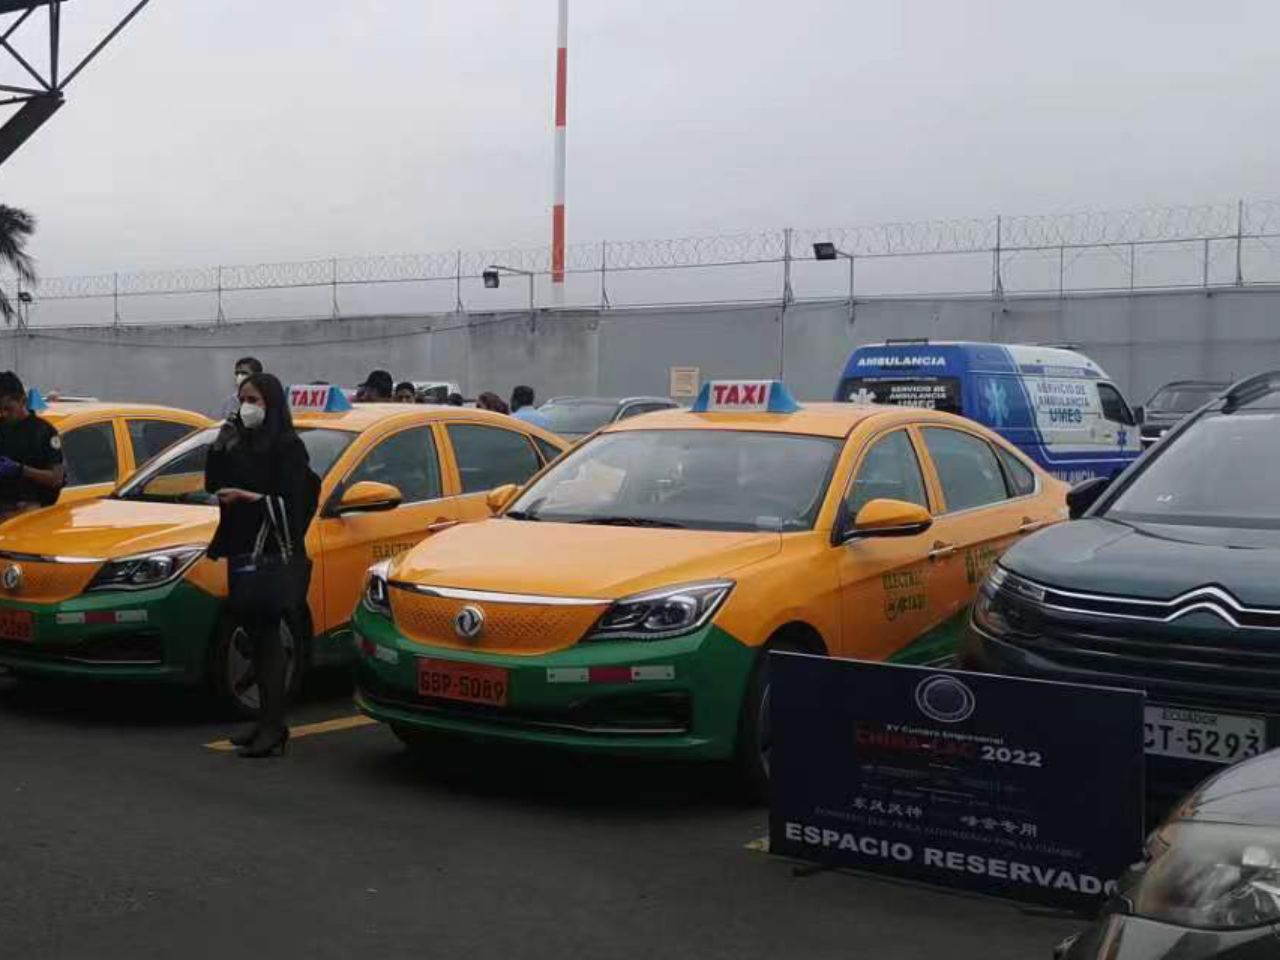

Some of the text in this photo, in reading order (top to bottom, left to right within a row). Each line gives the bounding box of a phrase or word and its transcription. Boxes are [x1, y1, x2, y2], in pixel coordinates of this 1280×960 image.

[857, 356, 946, 367] AMBULANCIA
[292, 389, 326, 407] TAXI
[714, 383, 766, 405] TAXI
[980, 745, 1044, 769] 2022
[785, 822, 914, 862] ESPACIO
